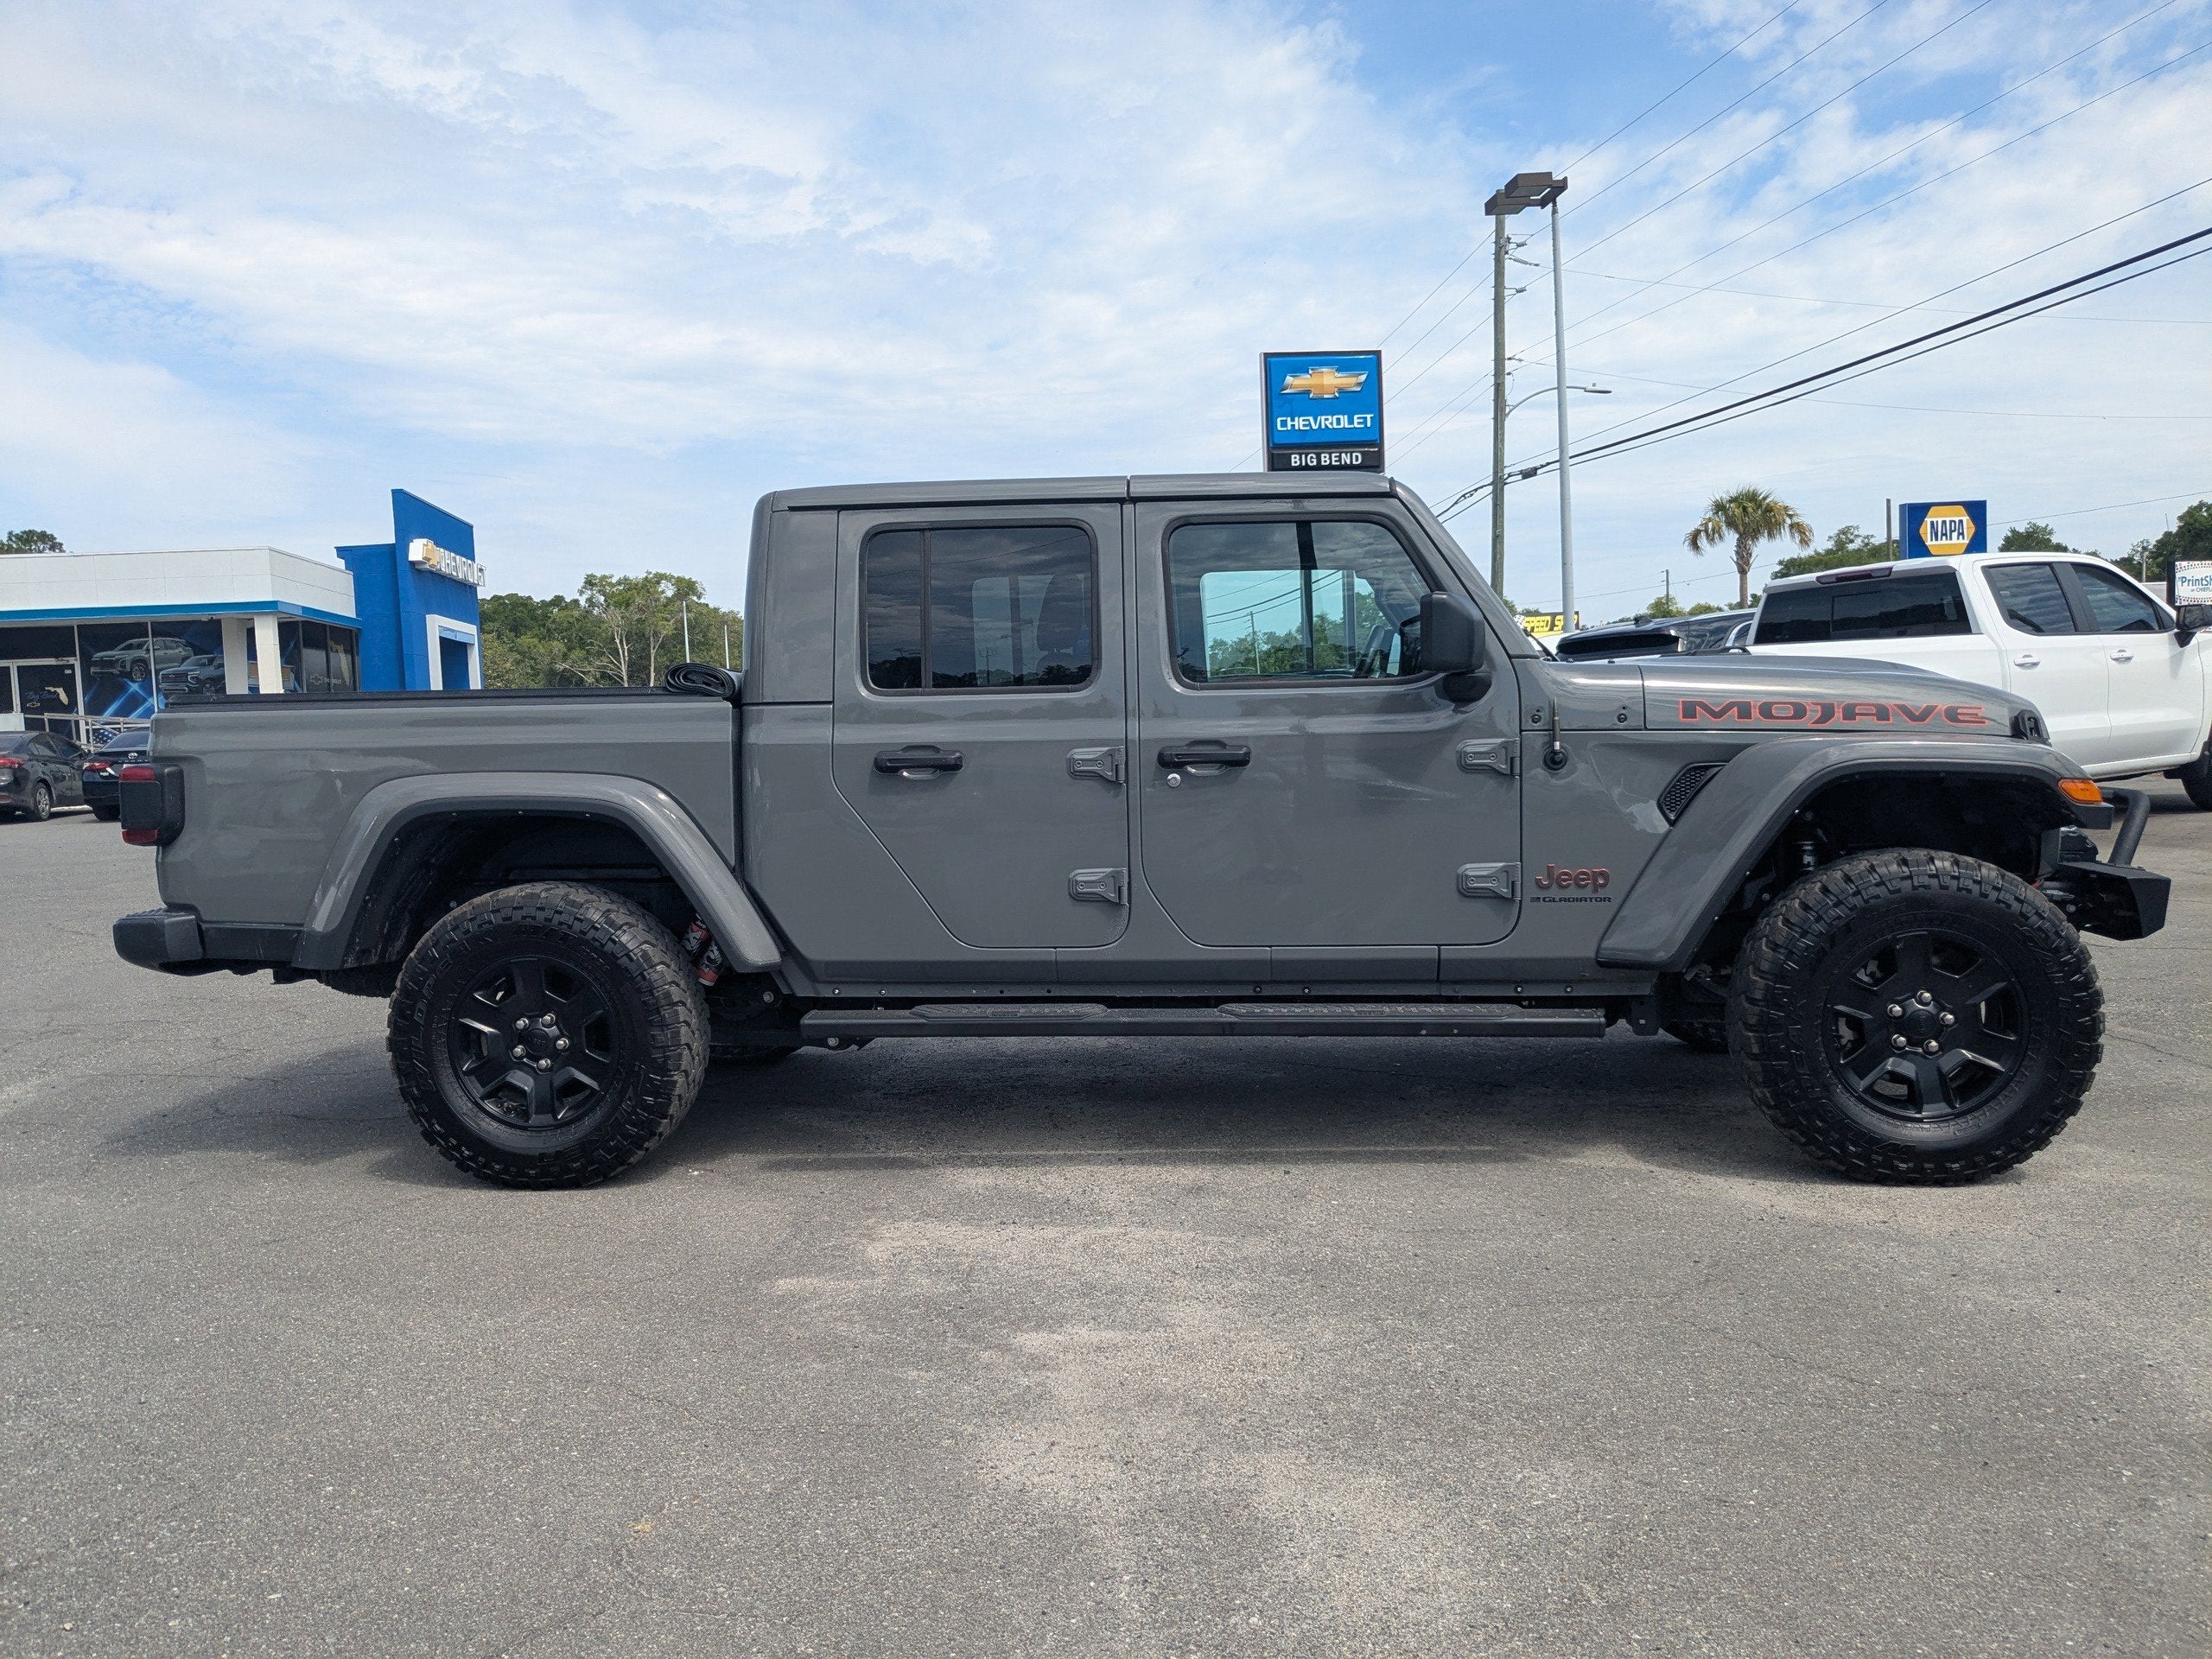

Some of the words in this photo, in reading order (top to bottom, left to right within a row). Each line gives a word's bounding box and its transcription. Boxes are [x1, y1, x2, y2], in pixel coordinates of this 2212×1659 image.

[1276, 414, 1374, 431] CHEVROLET
[1291, 454, 1317, 467] BIG
[1320, 453, 1363, 466] BEND
[1929, 518, 1966, 542] NAPA
[439, 547, 486, 588] CHEVROLET
[1679, 698, 1989, 727] MOJAVE
[1535, 863, 1611, 894] Jeep
